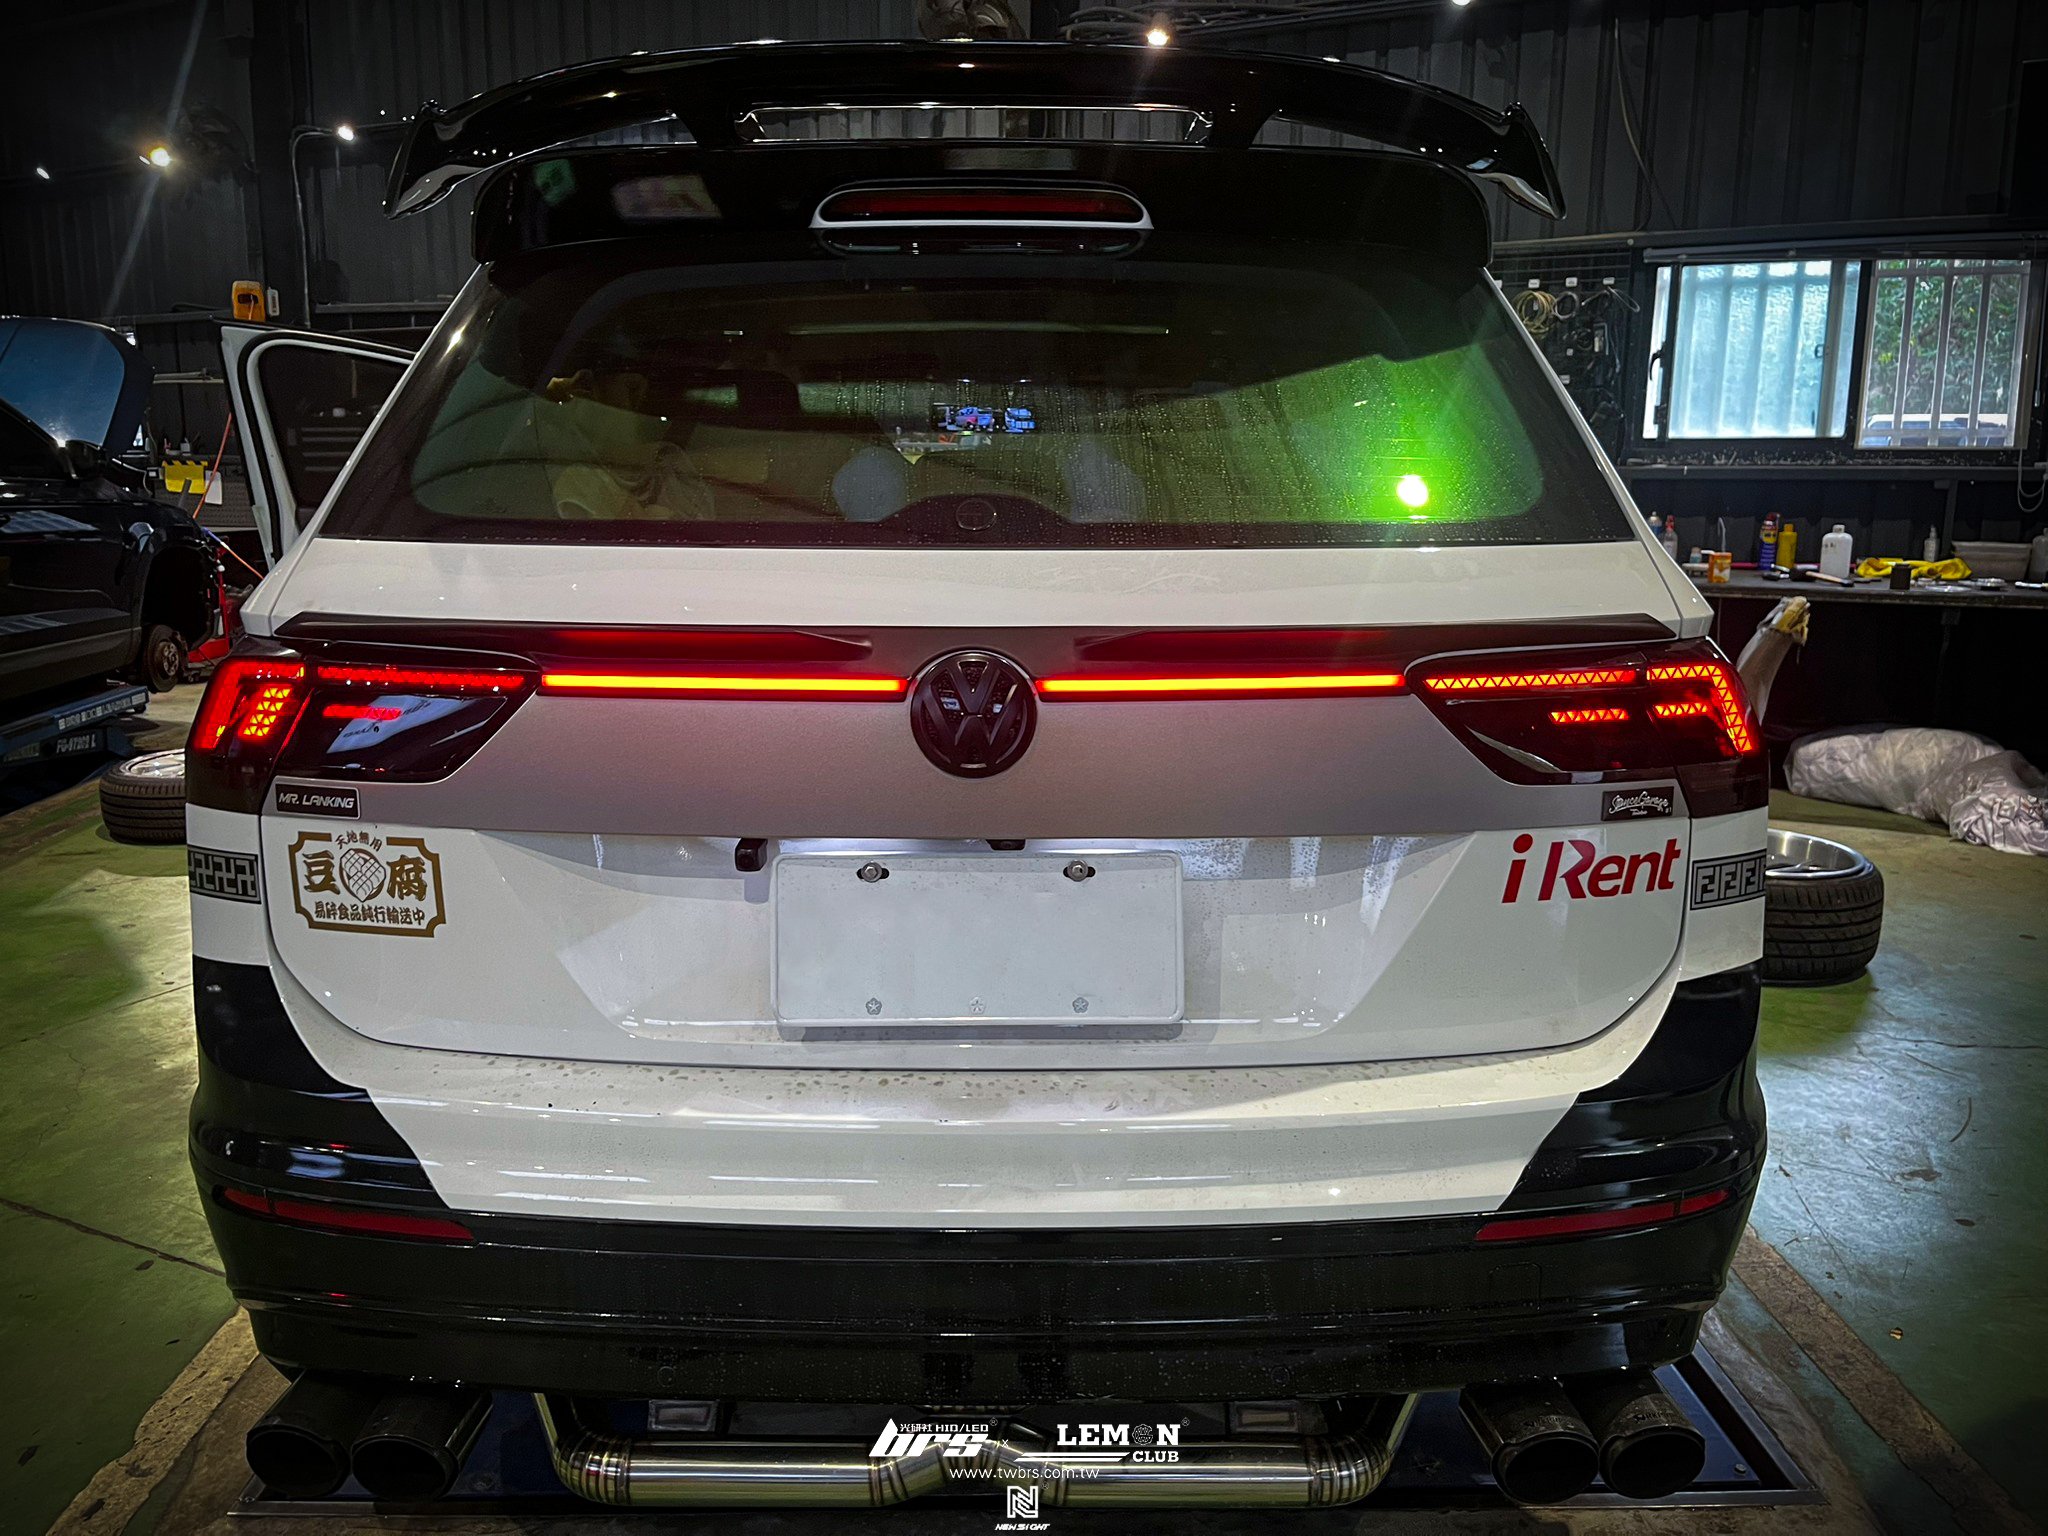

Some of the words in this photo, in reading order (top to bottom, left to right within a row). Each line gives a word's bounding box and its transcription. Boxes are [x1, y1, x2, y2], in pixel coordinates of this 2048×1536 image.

[279, 793, 300, 805] MR.
[302, 794, 355, 809] LANKING
[335, 830, 382, 852] 天地無用
